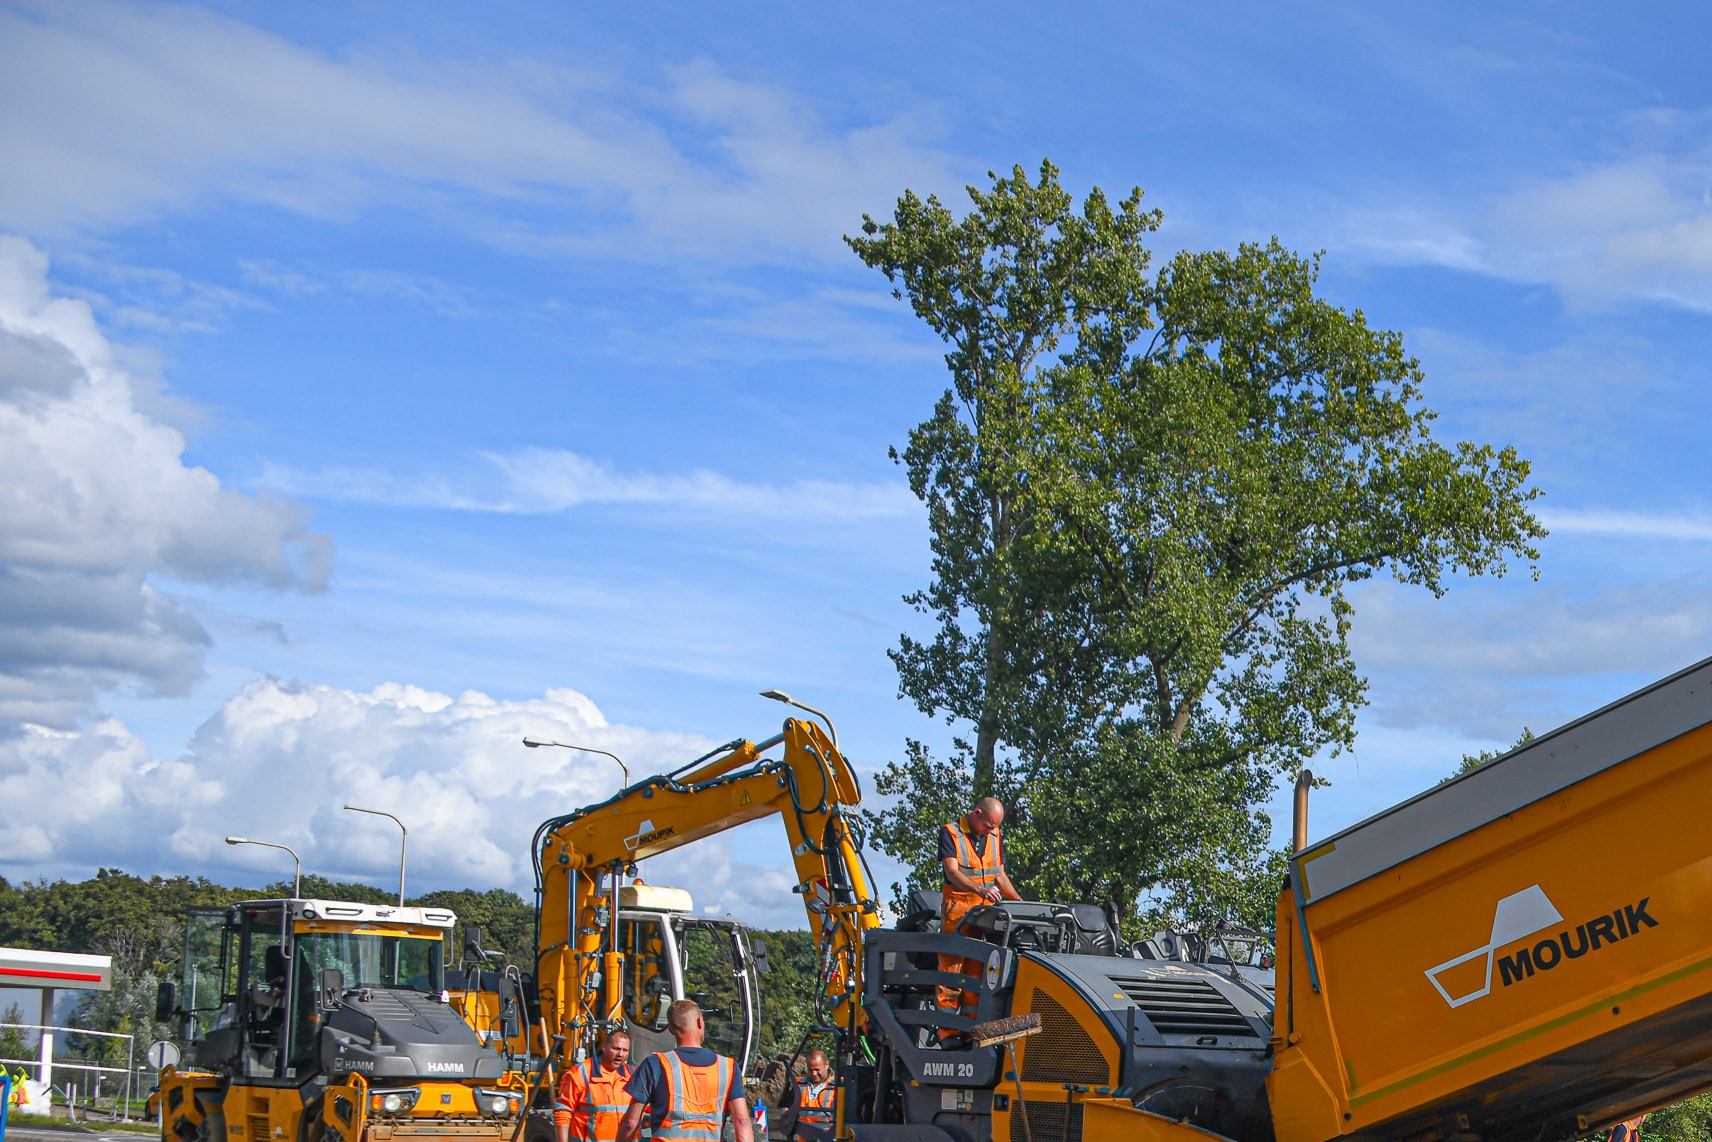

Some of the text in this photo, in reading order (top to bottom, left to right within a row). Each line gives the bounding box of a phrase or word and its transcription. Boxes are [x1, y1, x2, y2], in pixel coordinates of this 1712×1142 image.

[639, 826, 675, 846] MOURIK
[1497, 897, 1660, 987] MOURIK
[345, 1060, 375, 1071] HAMM
[427, 1061, 465, 1073] HAMM
[923, 1062, 974, 1078] AWM 20
